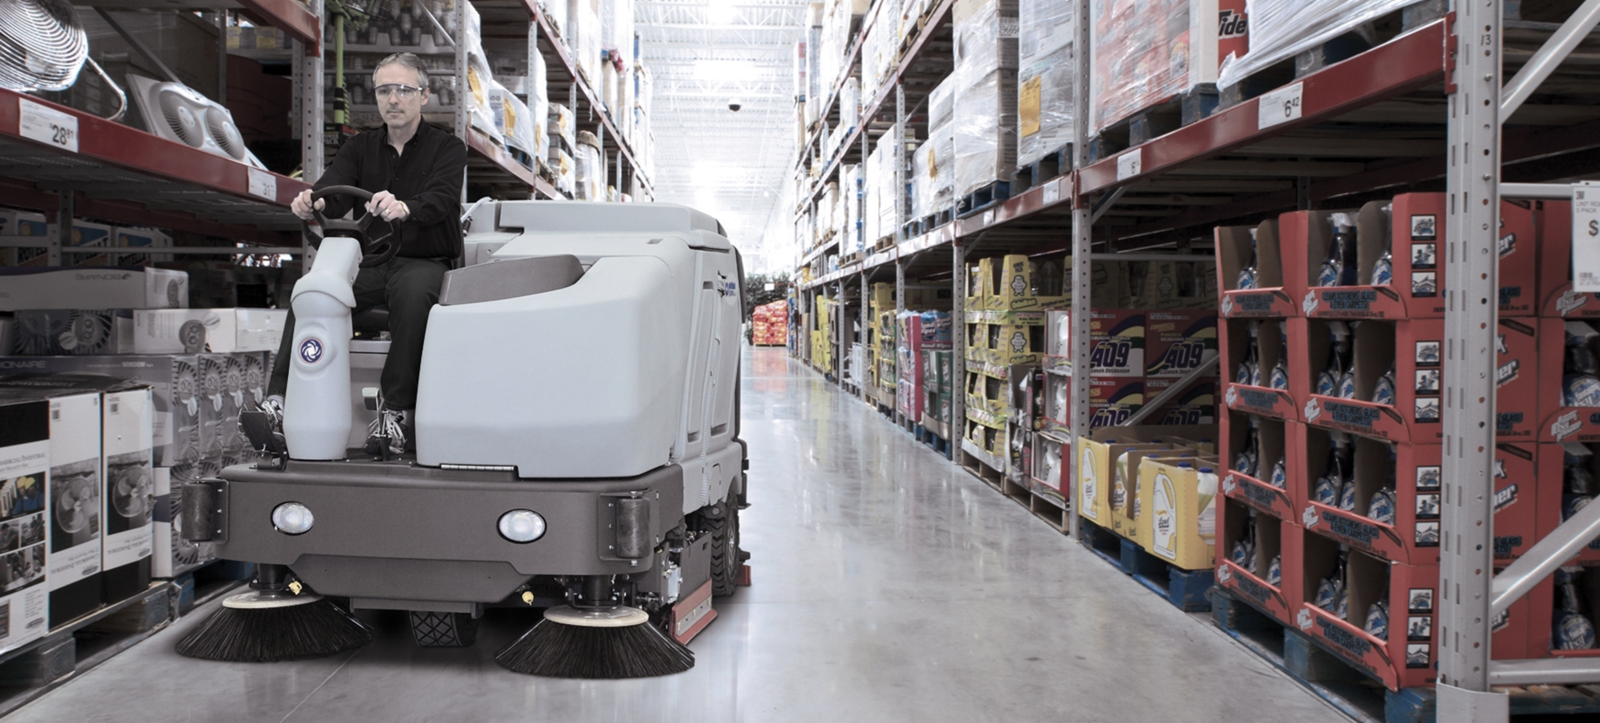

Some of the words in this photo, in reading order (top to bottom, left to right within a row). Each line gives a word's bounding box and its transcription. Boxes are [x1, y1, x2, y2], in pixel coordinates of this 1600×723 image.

[1481, 34, 1491, 46] 13
[1576, 191, 1585, 200] 3M
[1090, 341, 1131, 368] 409
[1164, 342, 1204, 368] 409
